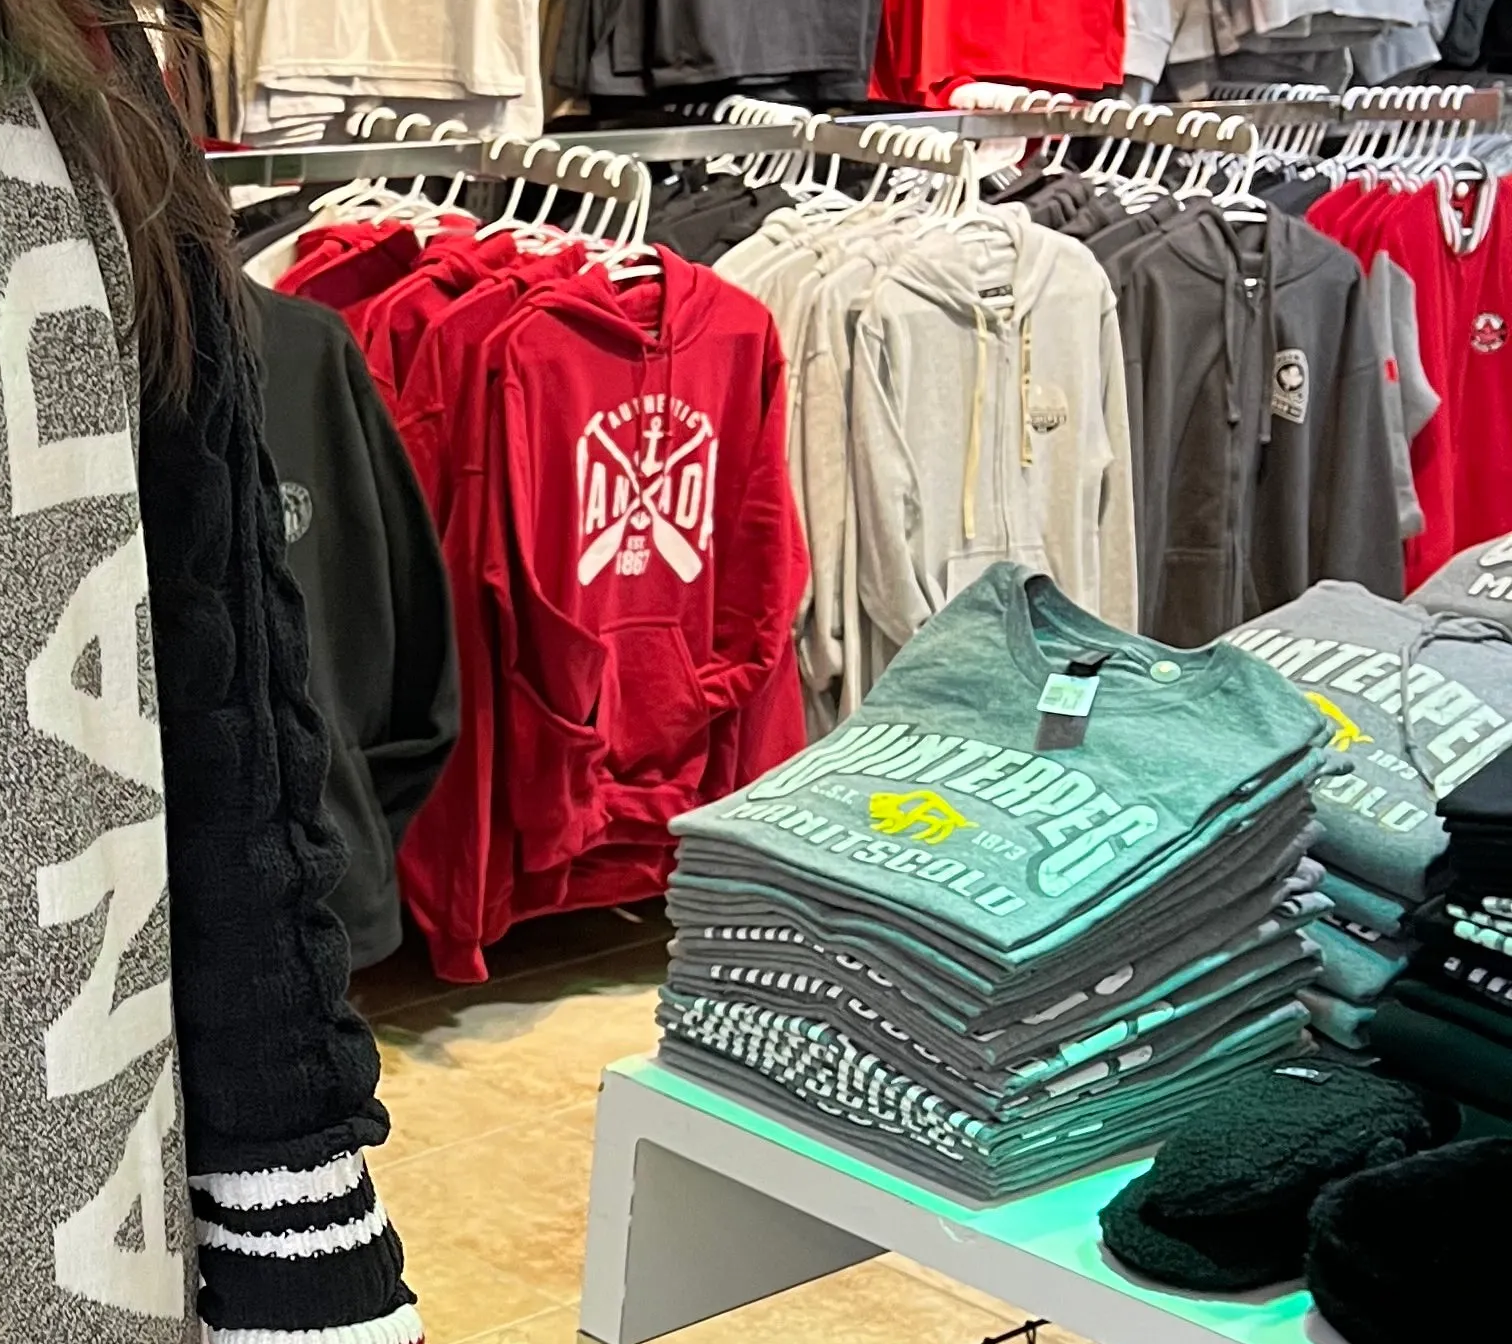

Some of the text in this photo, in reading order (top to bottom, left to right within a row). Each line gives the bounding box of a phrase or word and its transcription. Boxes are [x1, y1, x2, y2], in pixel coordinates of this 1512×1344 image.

[722, 802, 1028, 916] MANITSCOLD
[747, 722, 1159, 898] WINTERPEG
[972, 830, 1027, 861] 1873
